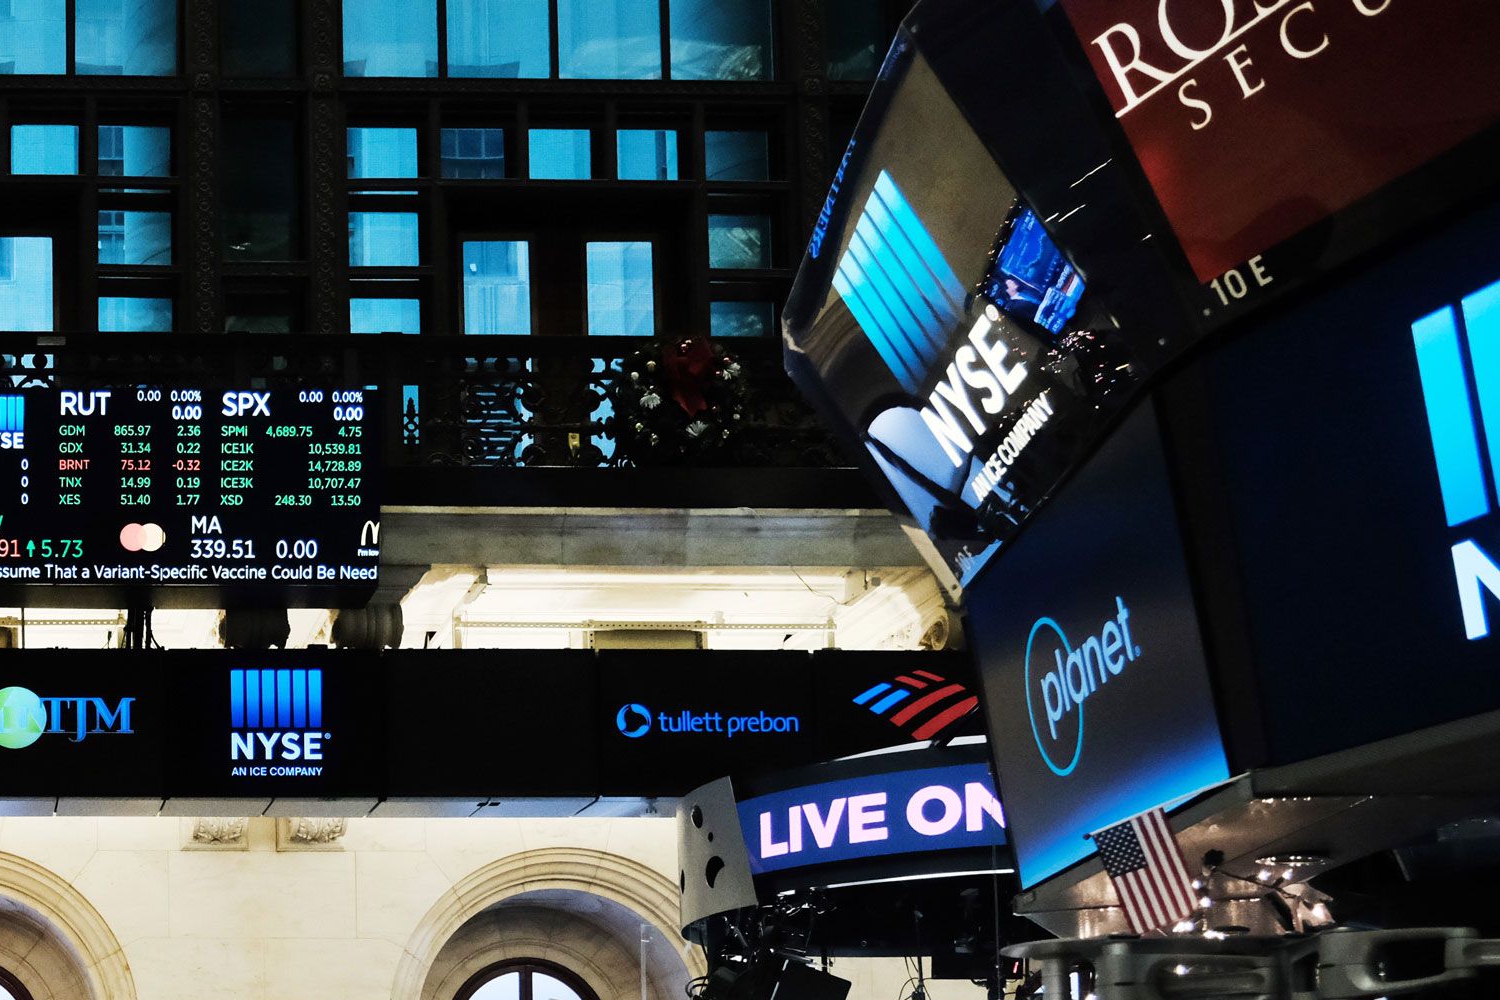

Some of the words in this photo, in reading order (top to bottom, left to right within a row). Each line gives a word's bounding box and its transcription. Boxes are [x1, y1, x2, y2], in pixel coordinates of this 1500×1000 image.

[1210, 269, 1248, 306] 10
[1248, 255, 1273, 287] E
[332, 391, 363, 403] 0.00%
[918, 312, 1028, 467] NYSE
[61, 390, 111, 416] RUT
[222, 391, 270, 416] SPX
[59, 425, 85, 436] GDM
[114, 425, 151, 436] 865.97
[177, 426, 200, 436] 2.36
[221, 426, 247, 436] SPMi
[266, 426, 312, 437] 4,689.75
[338, 426, 362, 437] 4.75
[997, 391, 1054, 466] COMPANY
[59, 443, 83, 453] GDX
[121, 443, 151, 453] 31.34
[177, 443, 200, 453] 0.22
[222, 443, 253, 453] ICE1K
[309, 444, 361, 455] 10,539.81
[60, 459, 89, 470] BRNT
[121, 460, 150, 470] 75.12
[172, 460, 200, 470] -0.32
[221, 460, 253, 471] ICE2K
[309, 461, 361, 472] 14,728.89
[59, 477, 81, 487] TNX
[121, 477, 150, 488] 14.99
[177, 477, 200, 488] 0.19
[221, 477, 253, 488] ICE3K
[309, 478, 361, 489] 10,707.47
[59, 494, 80, 504] XES
[121, 494, 150, 505] 51.40
[177, 495, 200, 505] 1.77
[220, 495, 243, 505] XSD
[275, 495, 311, 505] 248.30
[331, 495, 361, 506] 13.50
[192, 516, 222, 534] MA
[42, 540, 83, 558] 5.73
[191, 539, 255, 558] 339.51
[276, 540, 318, 558] 0.00
[44, 564, 77, 578] That
[82, 568, 89, 578] a
[94, 565, 207, 581] Variant-Specific
[212, 565, 266, 579] Vaccine
[272, 565, 312, 579] Could
[317, 564, 336, 579] Be
[340, 566, 377, 579] Need
[1039, 596, 1134, 738] planet
[658, 711, 723, 732] tullett
[728, 711, 799, 737] prebon
[231, 731, 323, 760] NYSE
[232, 767, 247, 776] AN
[250, 767, 267, 776] ICE
[270, 767, 322, 776] COMPANY
[759, 793, 888, 859] LIVE
[906, 782, 1006, 837] ON
